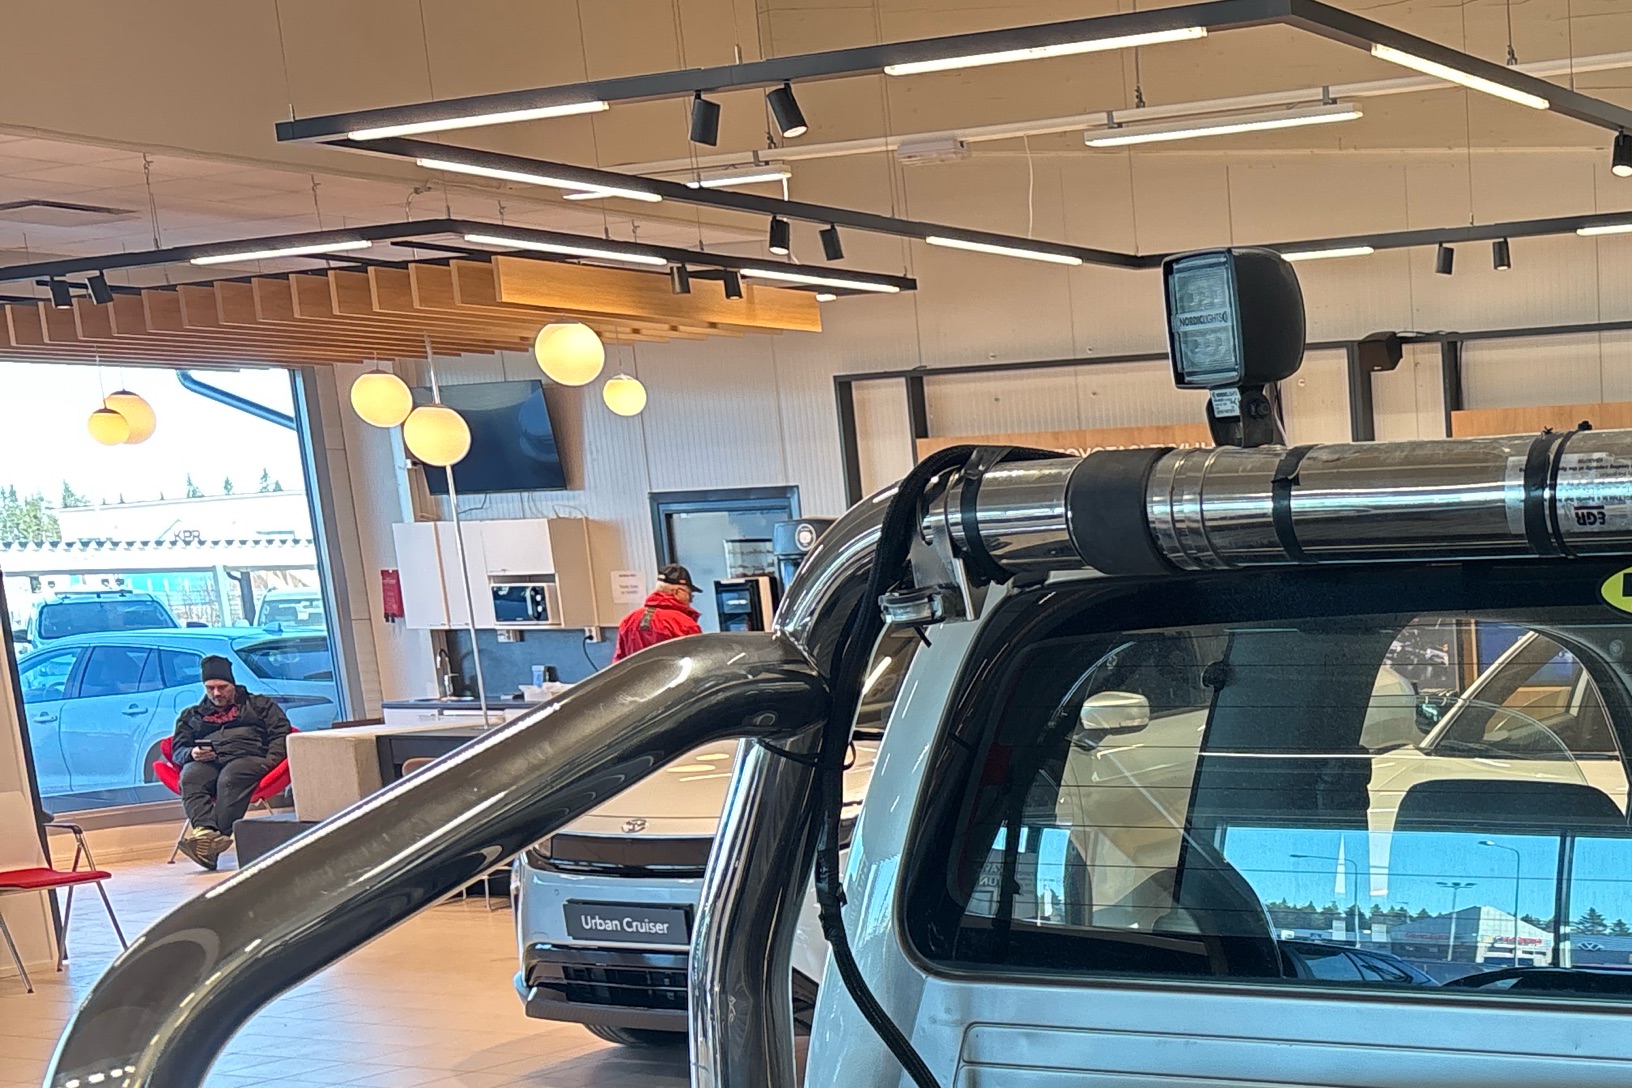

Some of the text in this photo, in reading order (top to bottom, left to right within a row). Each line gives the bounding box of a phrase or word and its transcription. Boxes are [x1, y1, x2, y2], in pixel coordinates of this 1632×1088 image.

[1574, 511, 1606, 526] EGR
[580, 914, 670, 935] Urban Cruiser
